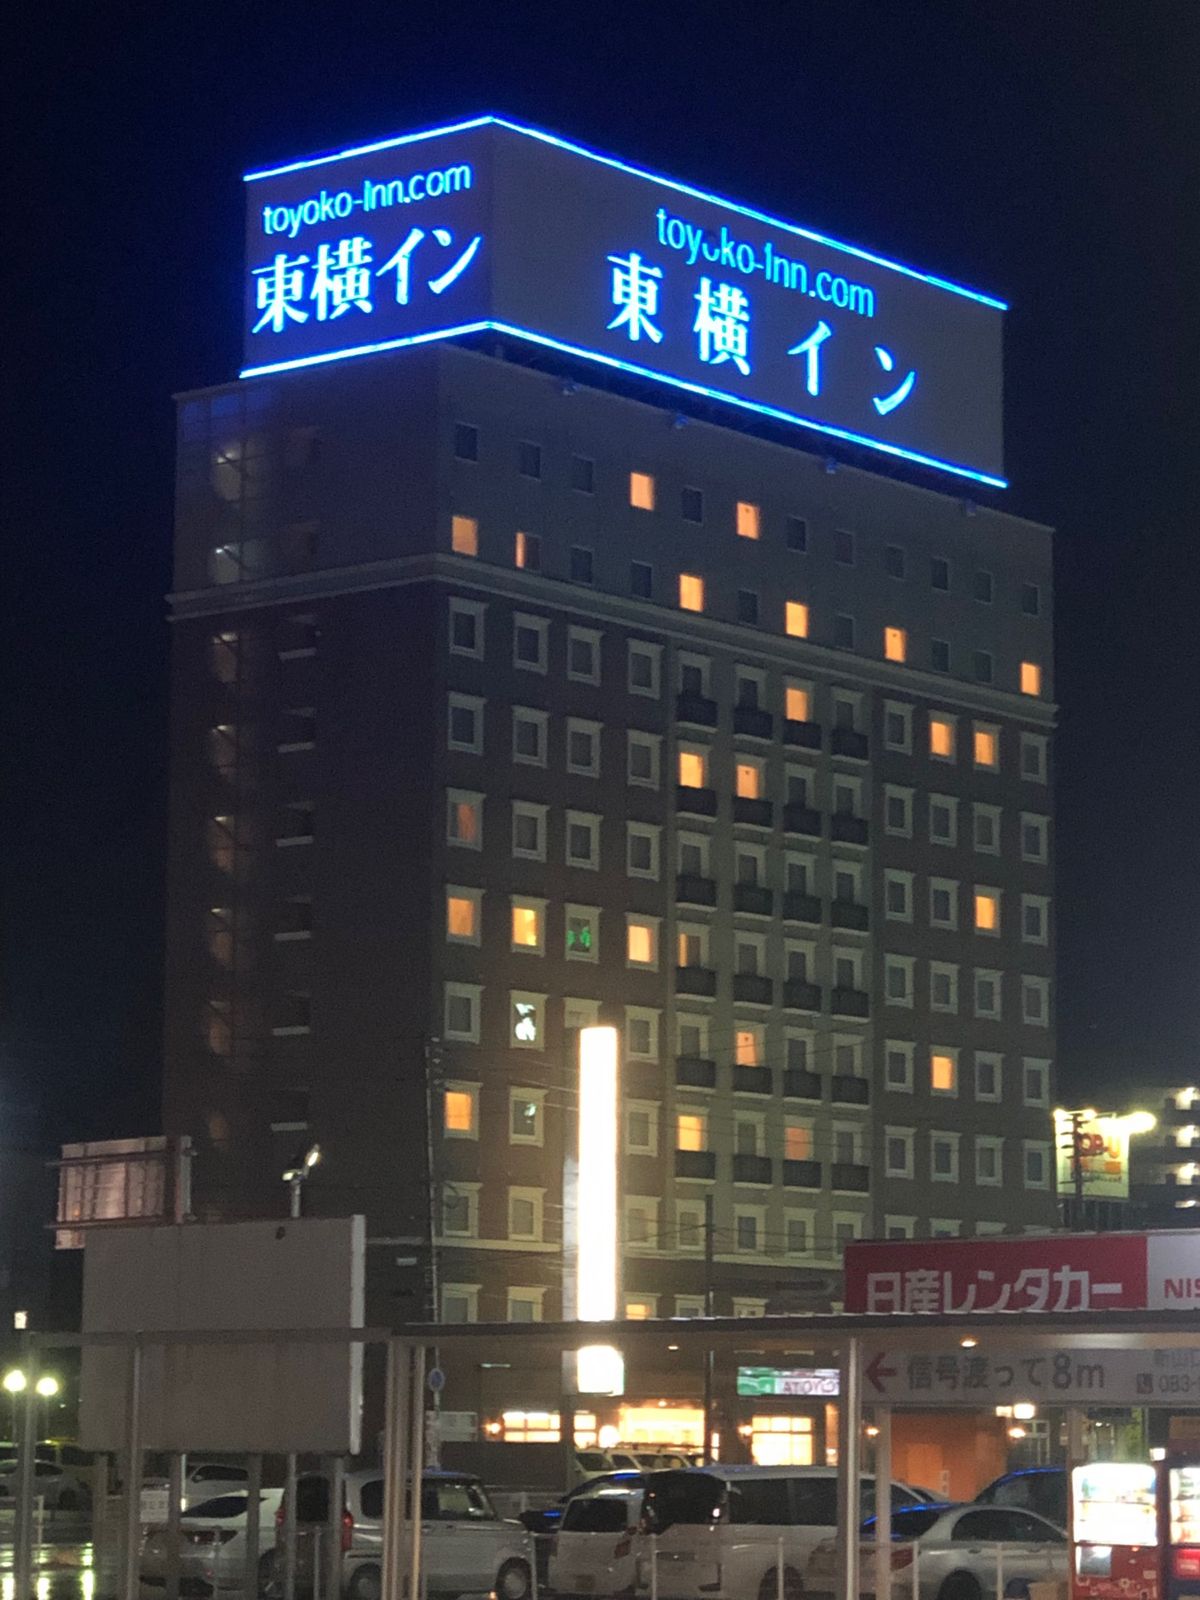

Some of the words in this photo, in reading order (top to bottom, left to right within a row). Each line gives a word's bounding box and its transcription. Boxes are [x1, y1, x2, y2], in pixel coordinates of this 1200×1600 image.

[251, 228, 481, 333] 東横イン
[607, 252, 915, 415] 東横イン
[866, 1264, 1123, 1313] 日産レンタカー
